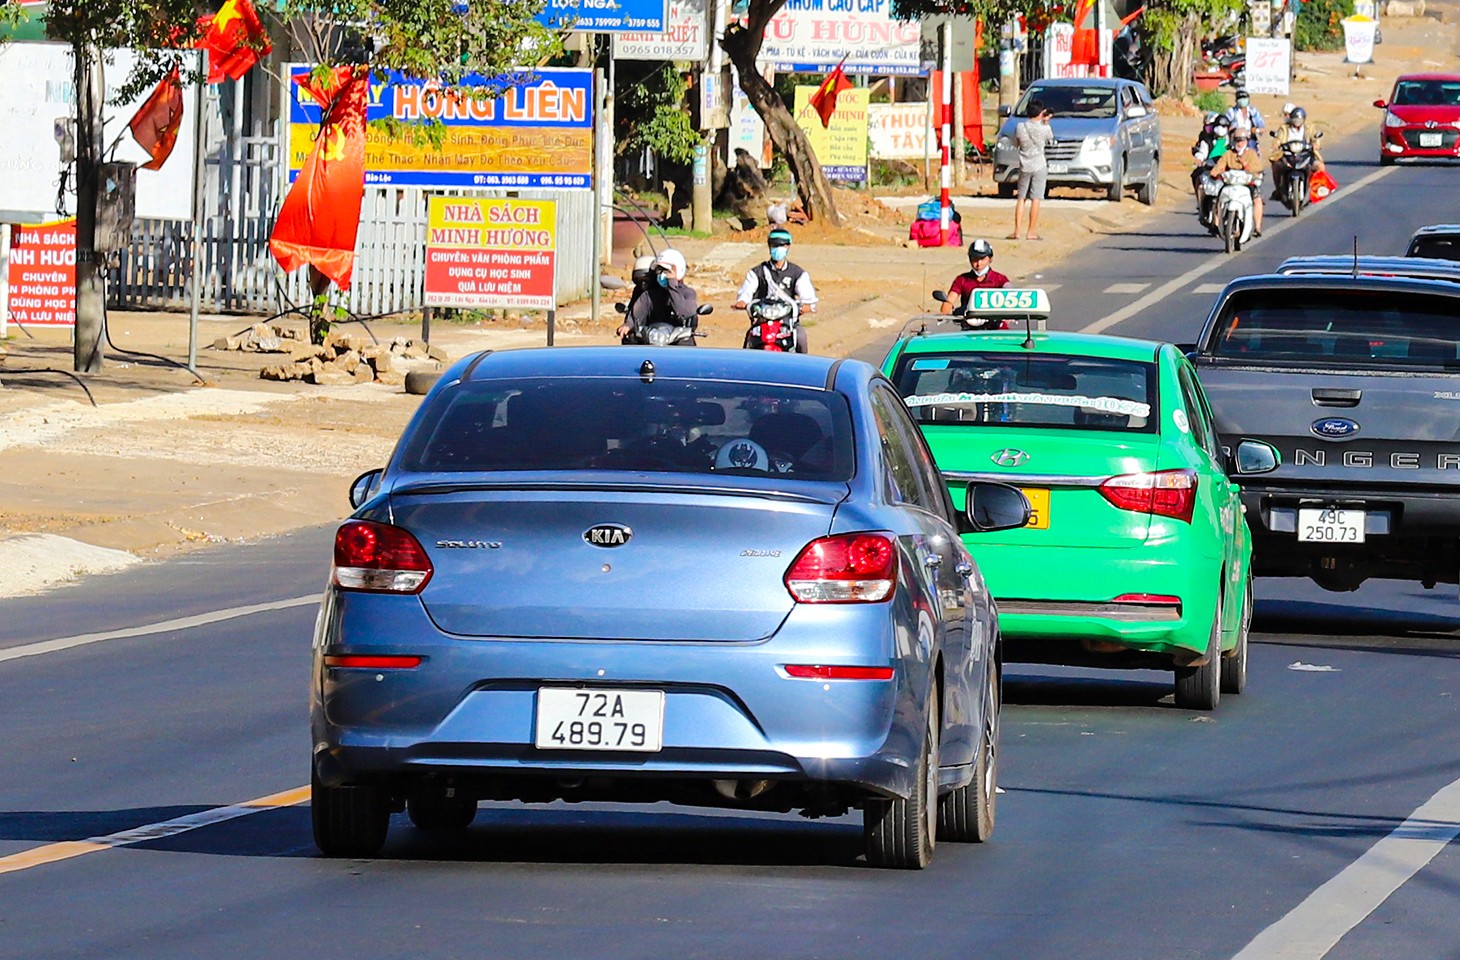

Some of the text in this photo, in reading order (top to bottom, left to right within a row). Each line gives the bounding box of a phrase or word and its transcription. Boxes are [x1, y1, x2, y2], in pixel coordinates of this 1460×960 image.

[811, 15, 920, 44] HÙNG
[623, 44, 650, 55] 0965
[653, 45, 672, 55] 018
[504, 80, 586, 121] LIÊN
[444, 202, 539, 223] NHÀ SÁCH
[16, 230, 75, 245] NHÀ SÁCH
[431, 227, 550, 246] MINH HƯƠNG
[22, 271, 67, 282] CHUYÊN
[490, 269, 508, 280] HỌC
[510, 269, 531, 279] SINH
[21, 284, 59, 295] PHÒNG
[979, 290, 1034, 309] 1055
[1318, 511, 1345, 524] 49C
[1306, 526, 1357, 541] 250.73
[576, 693, 624, 718] 72A
[551, 721, 646, 746] 489.79
